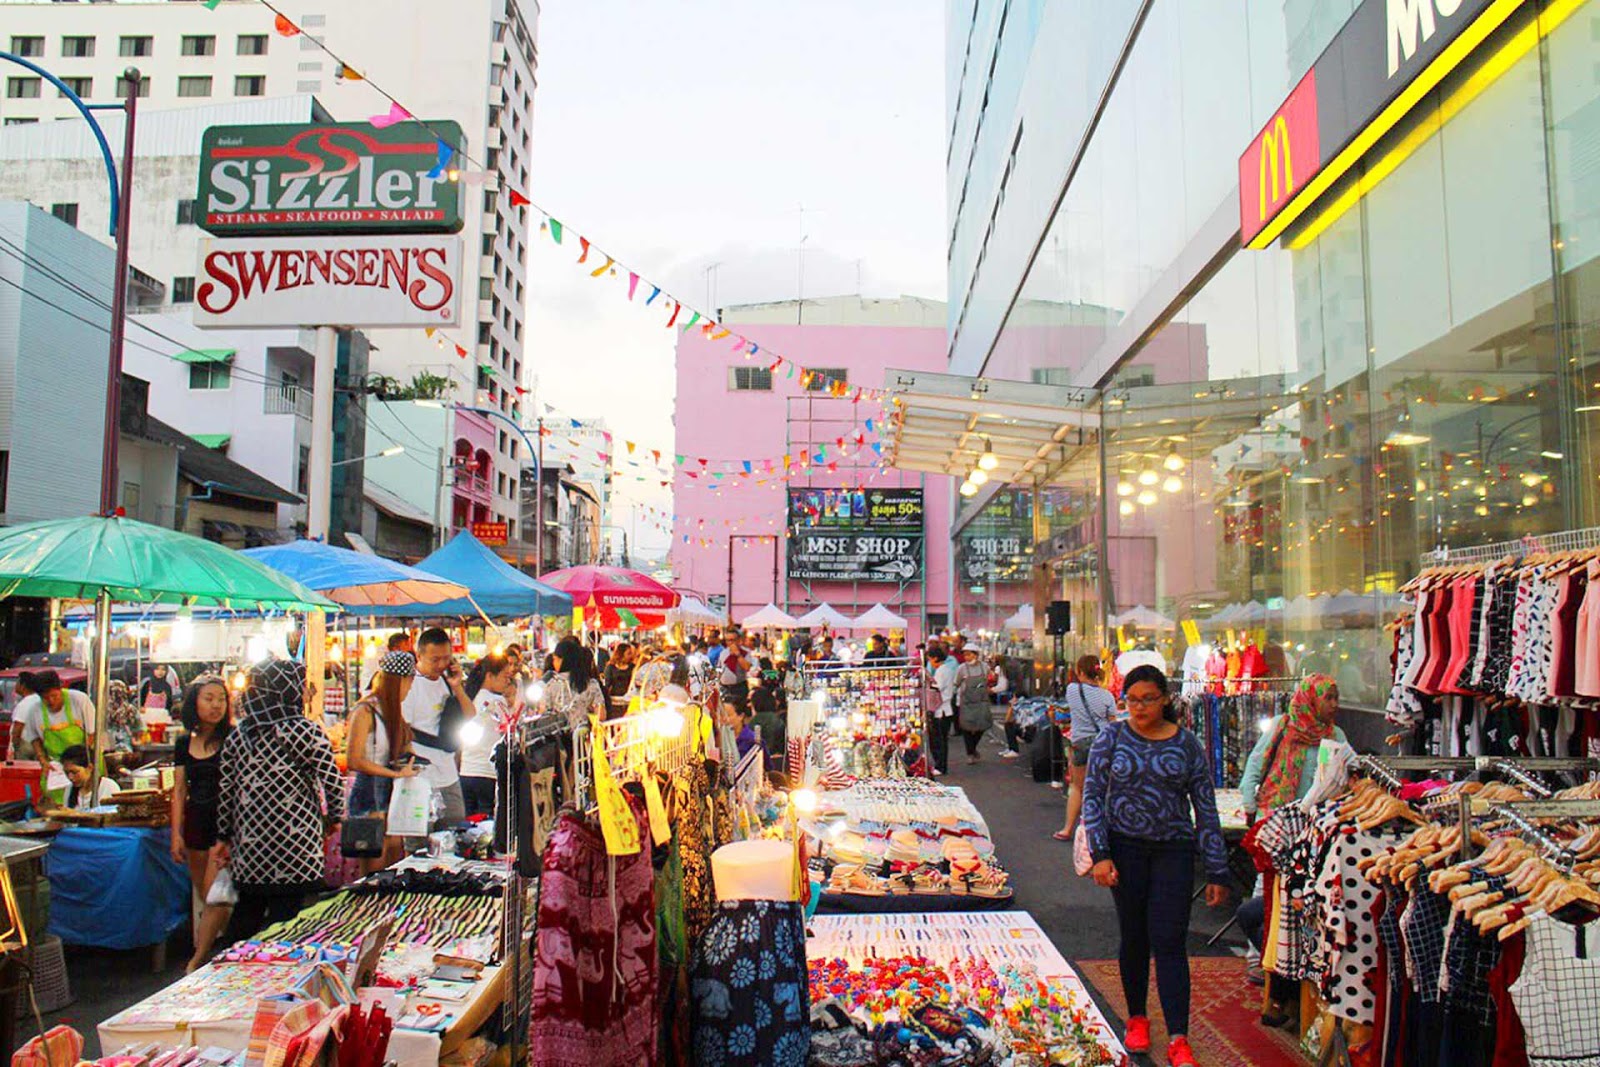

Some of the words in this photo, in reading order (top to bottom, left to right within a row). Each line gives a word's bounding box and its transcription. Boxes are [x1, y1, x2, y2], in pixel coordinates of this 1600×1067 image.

[207, 155, 448, 213] Sizzler
[215, 213, 268, 224] STEAK
[286, 211, 363, 222] SEAFOOD
[380, 210, 435, 221] SALAD
[197, 247, 454, 315] SWENSEN'S
[855, 537, 910, 555] SHOP
